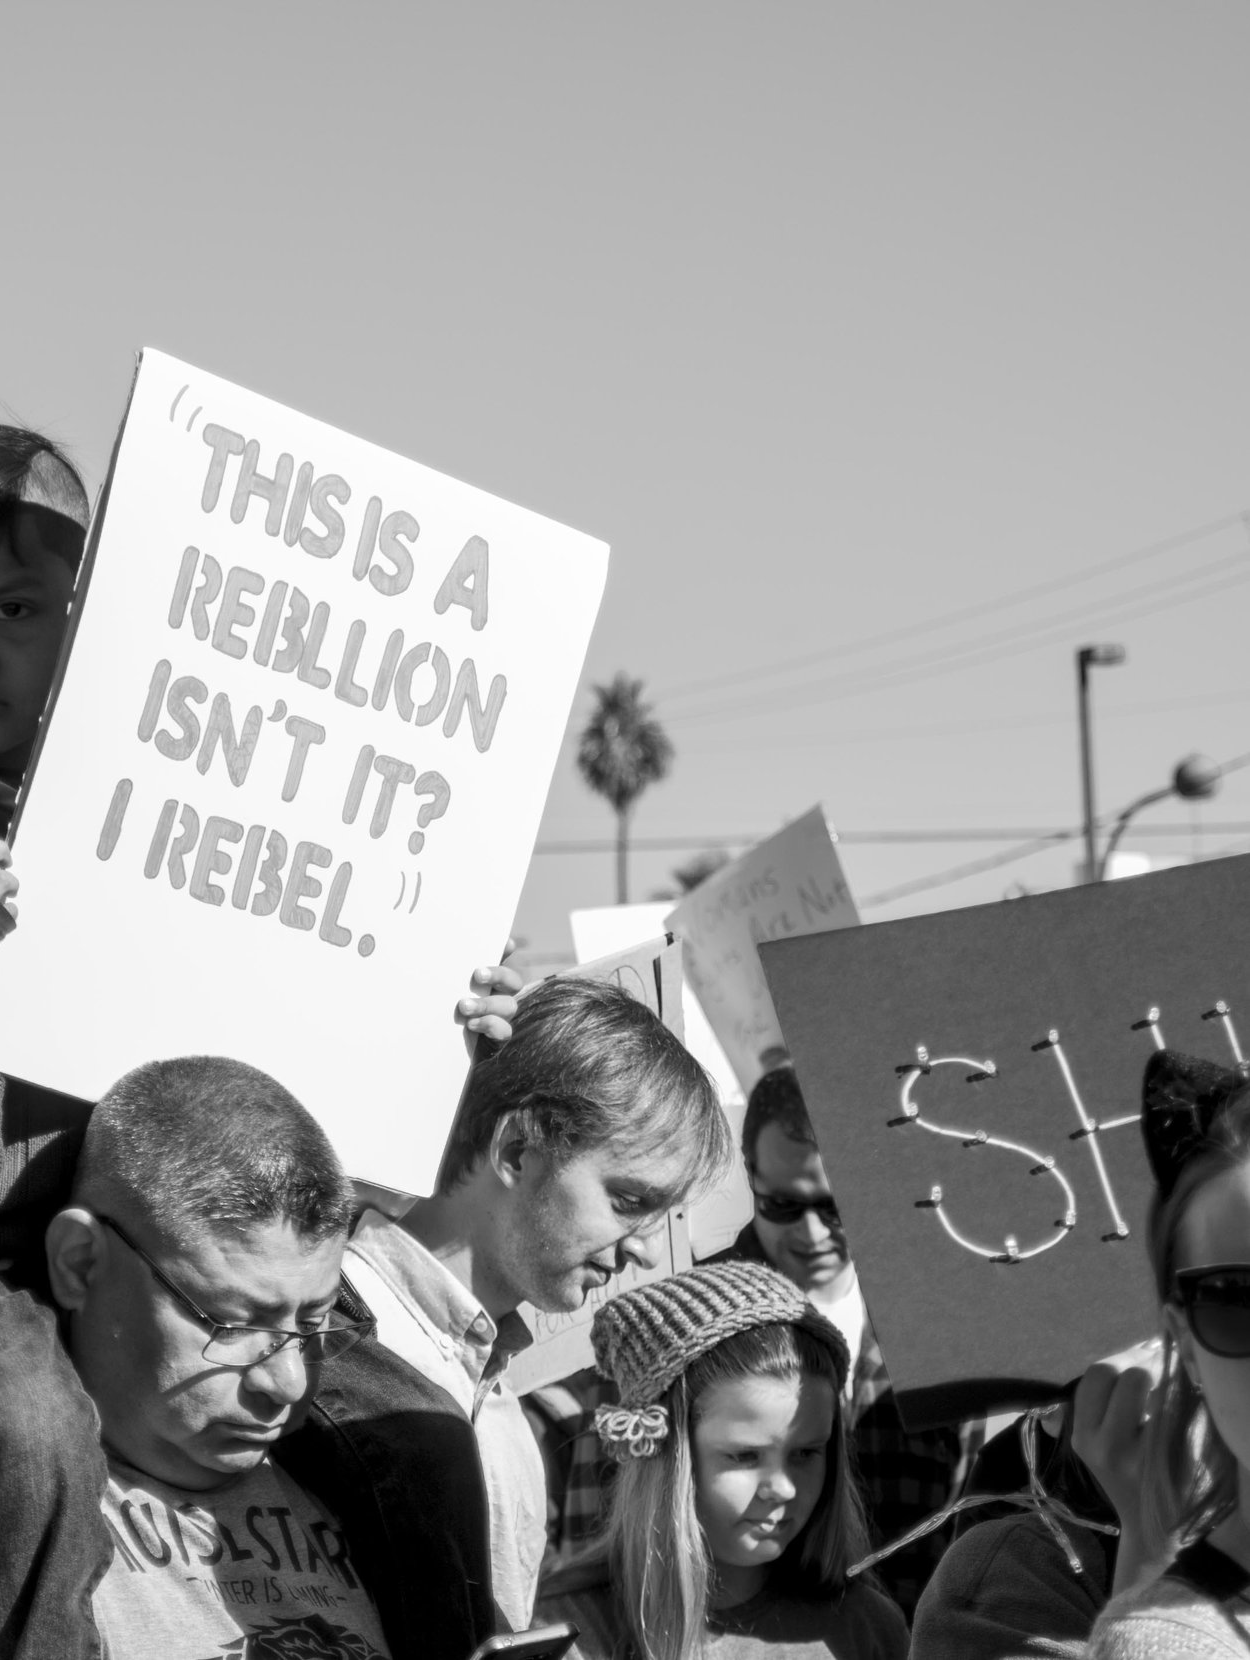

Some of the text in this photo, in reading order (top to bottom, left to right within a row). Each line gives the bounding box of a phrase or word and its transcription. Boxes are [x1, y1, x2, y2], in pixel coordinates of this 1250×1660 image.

[352, 495, 421, 597] IS
[434, 534, 490, 632] A
[168, 545, 508, 754] REBLLION
[96, 778, 134, 862] I
[137, 658, 452, 856] ISN'T IT?
[262, 1576, 283, 1604] IS
